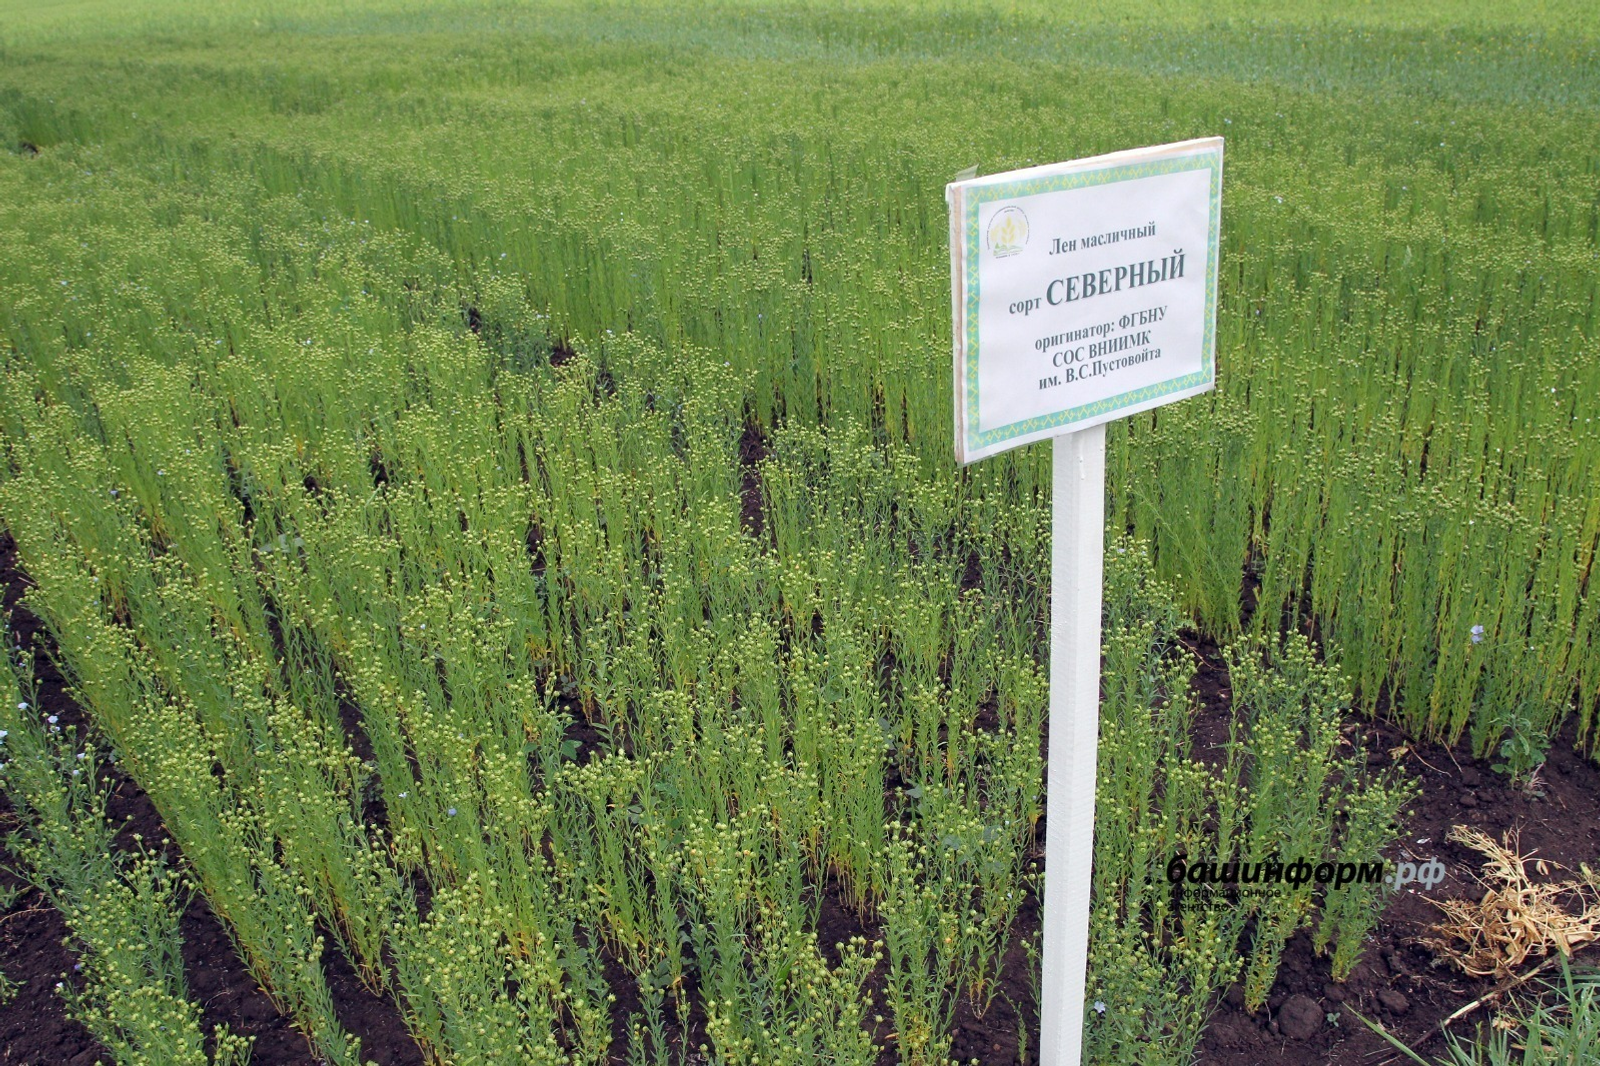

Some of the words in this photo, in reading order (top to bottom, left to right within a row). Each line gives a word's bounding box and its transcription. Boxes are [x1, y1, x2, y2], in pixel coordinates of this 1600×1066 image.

[1049, 238, 1077, 256] Лен
[1081, 221, 1156, 249] масличный
[1009, 297, 1041, 316] сорт
[1046, 249, 1185, 306] СЕВЕРНЫЙ
[1035, 320, 1115, 351] оригинатор:
[1119, 307, 1167, 330] ФГБНУ
[1053, 348, 1085, 368] СОС
[1089, 331, 1151, 359] ВНИИМК
[1039, 376, 1061, 390] им.
[1066, 349, 1161, 383] В.С.Пустовойта
